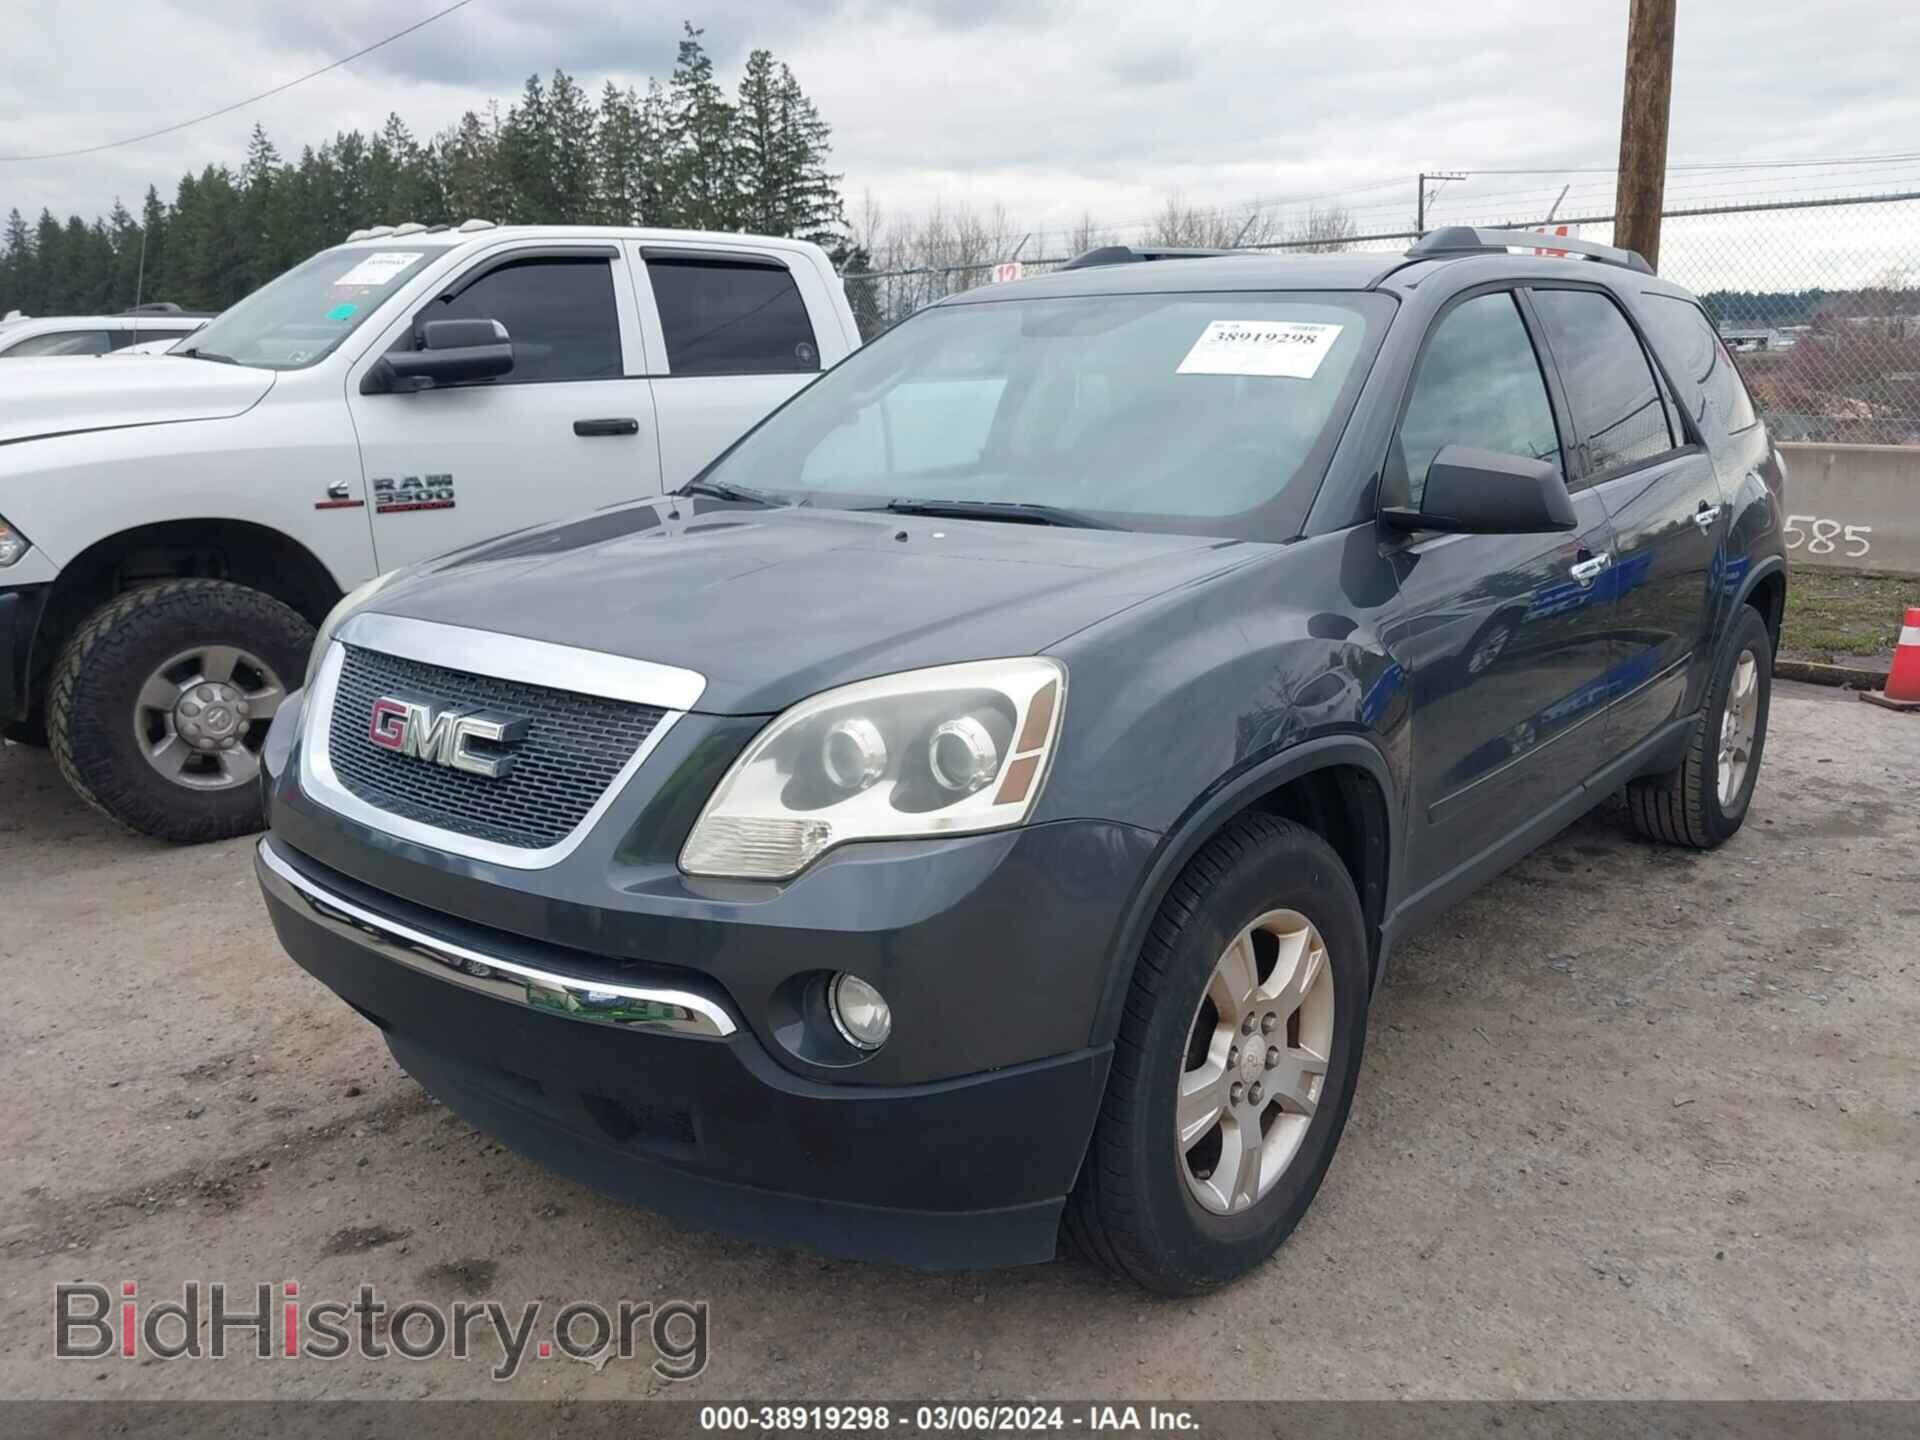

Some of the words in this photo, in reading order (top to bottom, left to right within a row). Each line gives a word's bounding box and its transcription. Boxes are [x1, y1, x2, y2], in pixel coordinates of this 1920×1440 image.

[1216, 331, 1318, 344] 38919298
[374, 475, 453, 490] RAM
[375, 488, 454, 504] 3500
[369, 697, 528, 778] GMC
